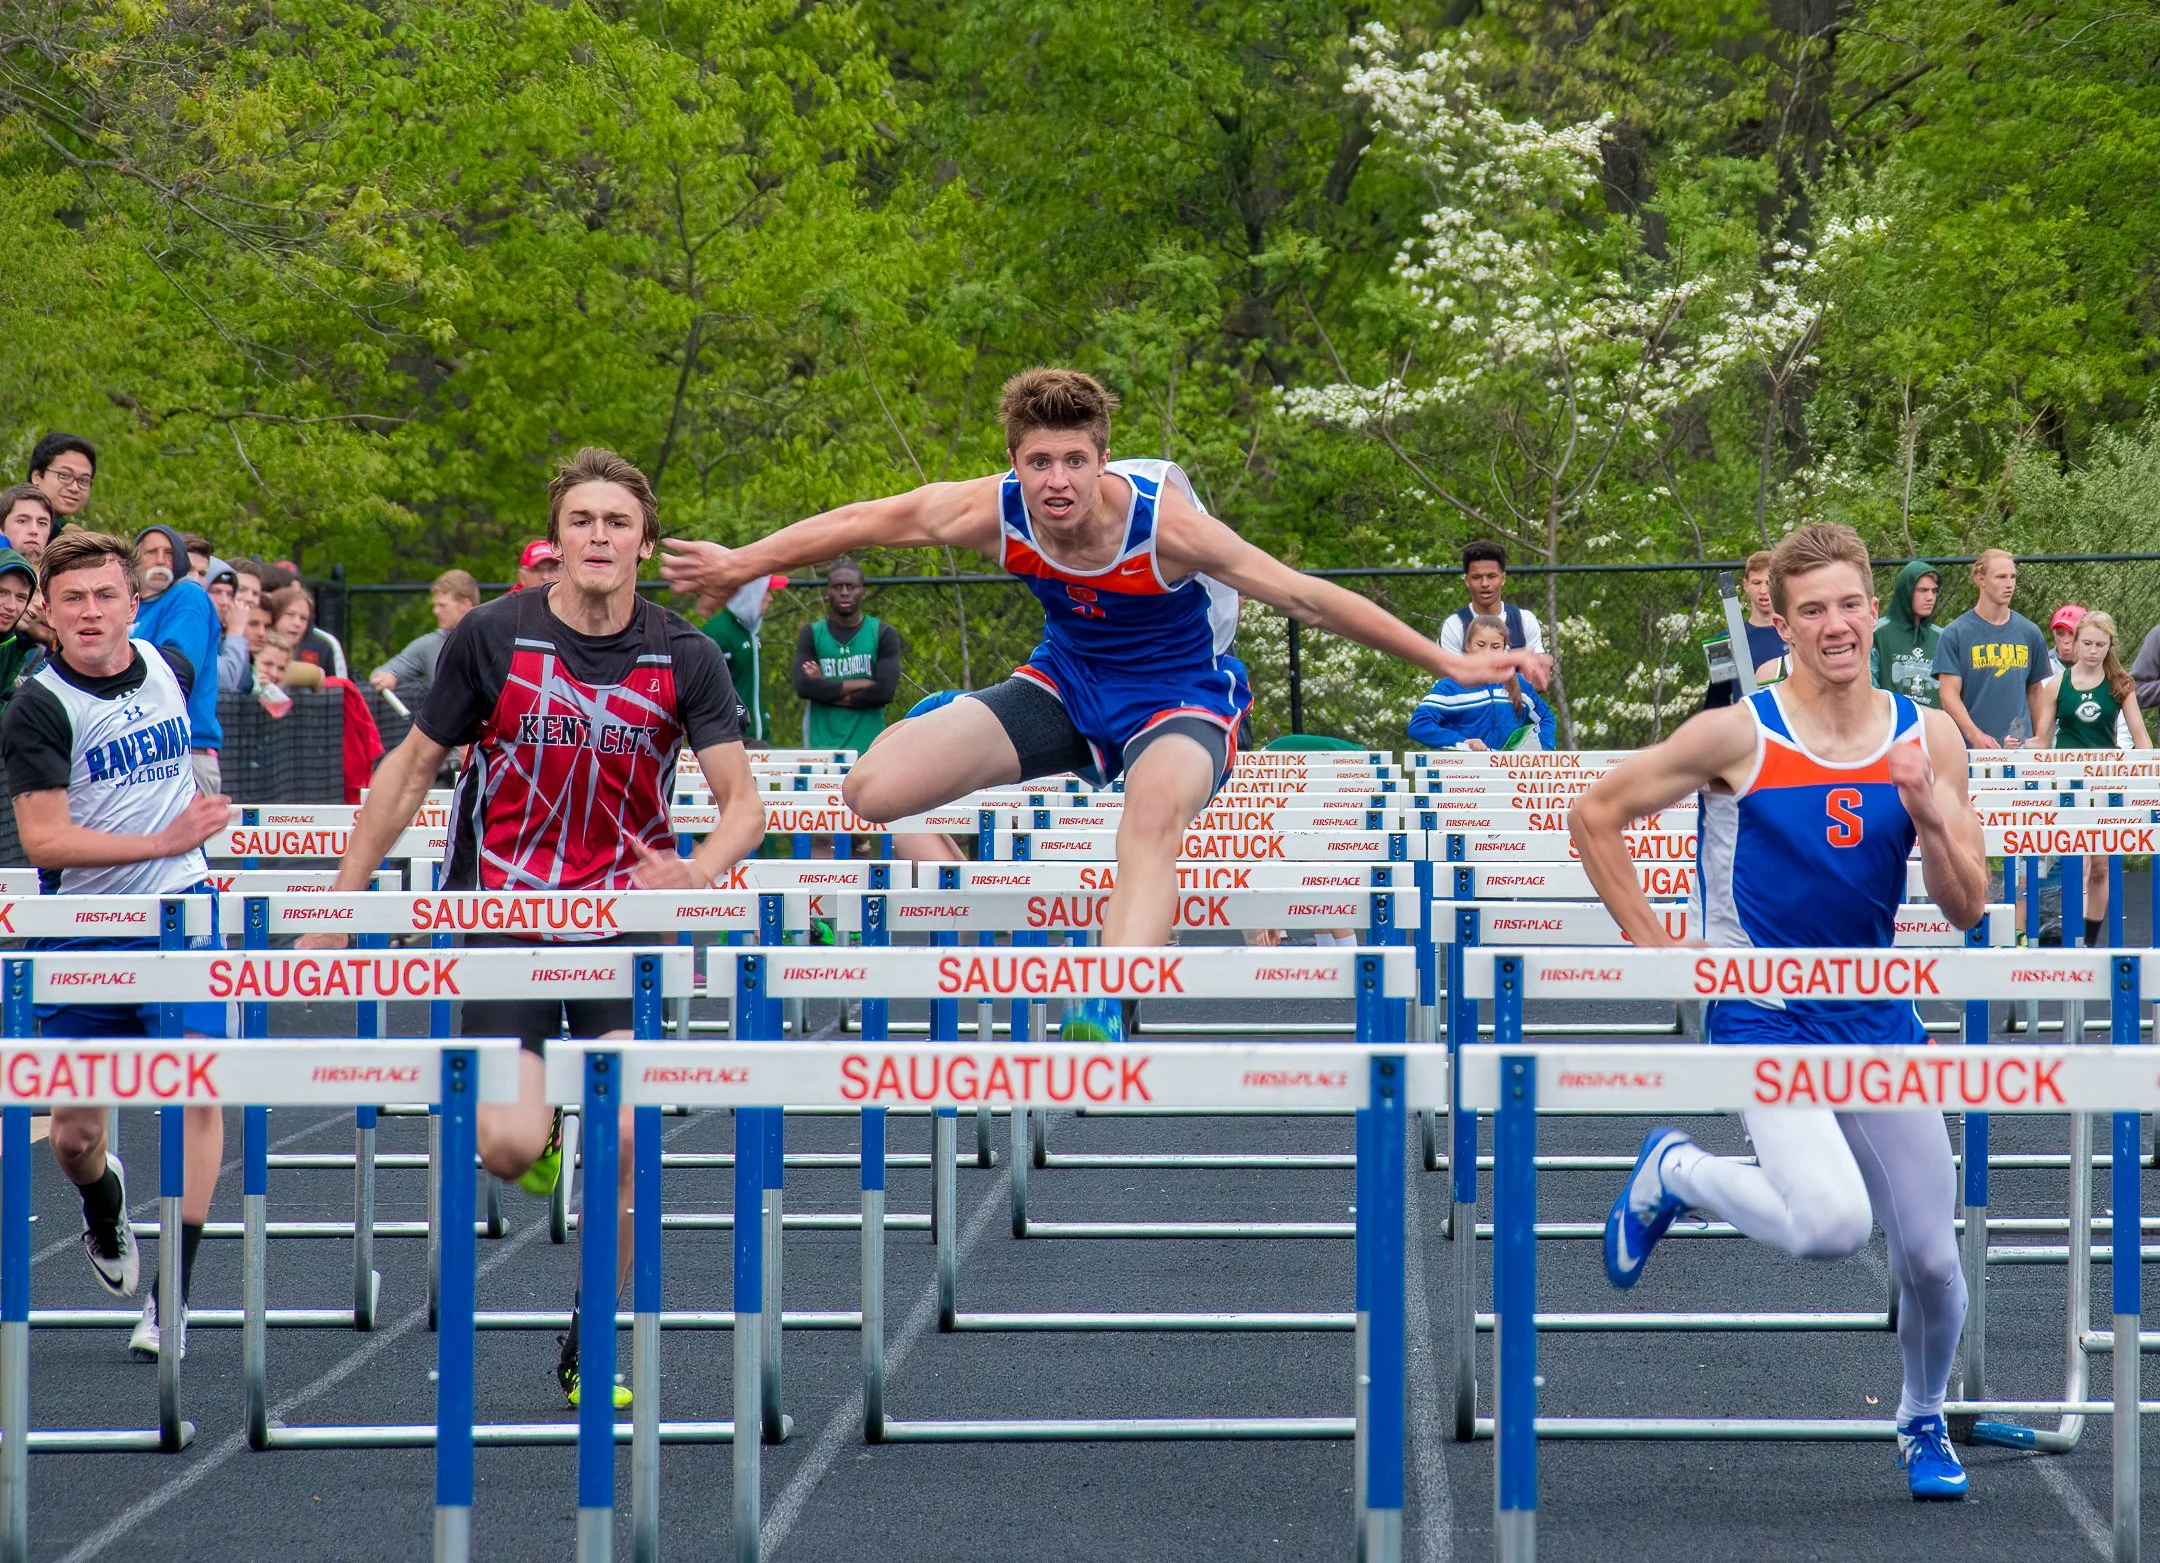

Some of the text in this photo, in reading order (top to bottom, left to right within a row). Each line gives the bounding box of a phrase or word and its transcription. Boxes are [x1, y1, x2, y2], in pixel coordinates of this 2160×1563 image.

[85, 716, 192, 783] RAVENNA
[520, 714, 660, 756] KENT CITY
[1235, 755, 1307, 765] UGATUCK
[1489, 754, 1579, 767] SAUGATUCK
[767, 811, 887, 831] AUGATUCK
[1188, 812, 1275, 830] GATUCK
[1826, 788, 1863, 848] S
[231, 832, 348, 855] SAUGATU
[1177, 835, 1286, 859] GATUCK
[2004, 829, 2154, 854] SAUGATUCK
[412, 899, 617, 929] SAUGATUCK
[209, 959, 459, 997] SAUGATUCK
[939, 957, 1183, 993] SAUGATUCK
[1695, 958, 1939, 995] SAUGATUCK
[0, 1053, 219, 1098] GATUCK
[840, 1055, 1150, 1102] SAUGATUCK
[1755, 1059, 2064, 1105] SAUGATUCK
